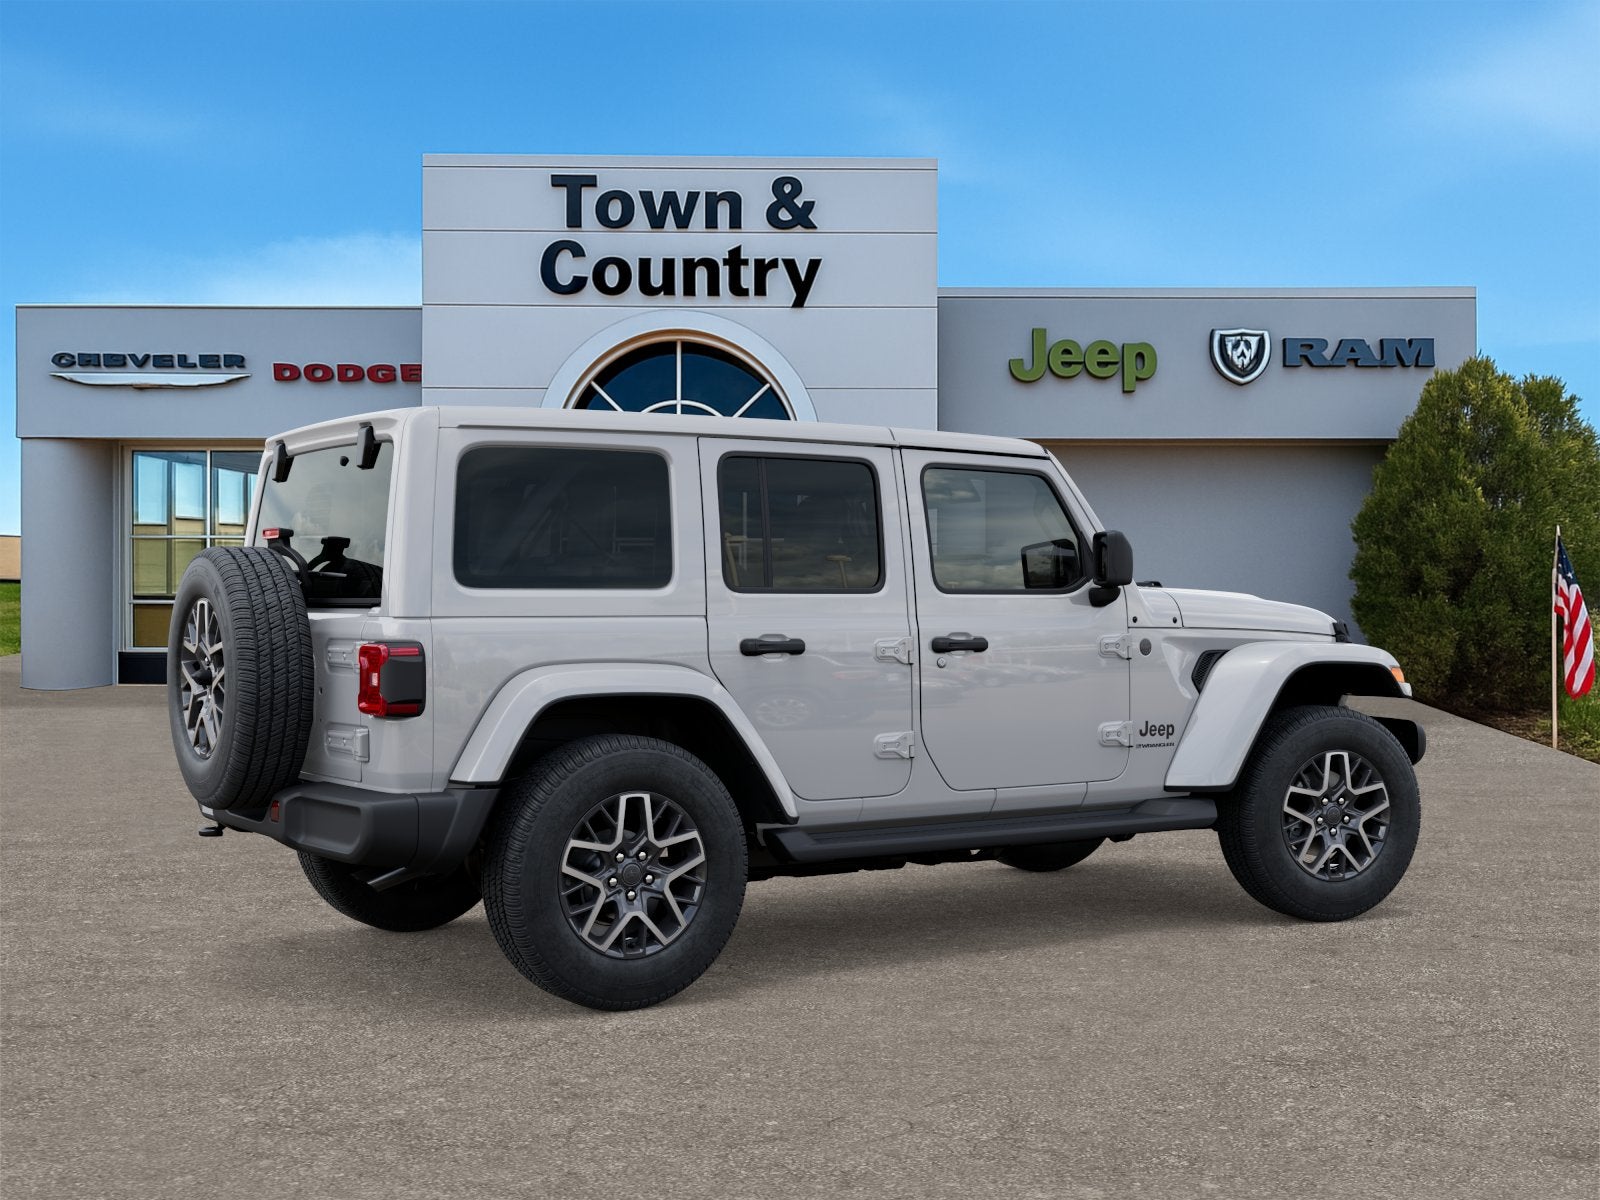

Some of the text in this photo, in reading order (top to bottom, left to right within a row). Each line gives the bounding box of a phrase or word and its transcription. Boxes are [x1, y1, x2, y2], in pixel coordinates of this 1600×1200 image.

[551, 174, 817, 229] Town &
[540, 239, 822, 308] Country
[273, 363, 422, 382] DODGE
[1009, 328, 1158, 393] Jeep
[1283, 338, 1435, 367] RAM
[1139, 720, 1174, 740] Jeep
